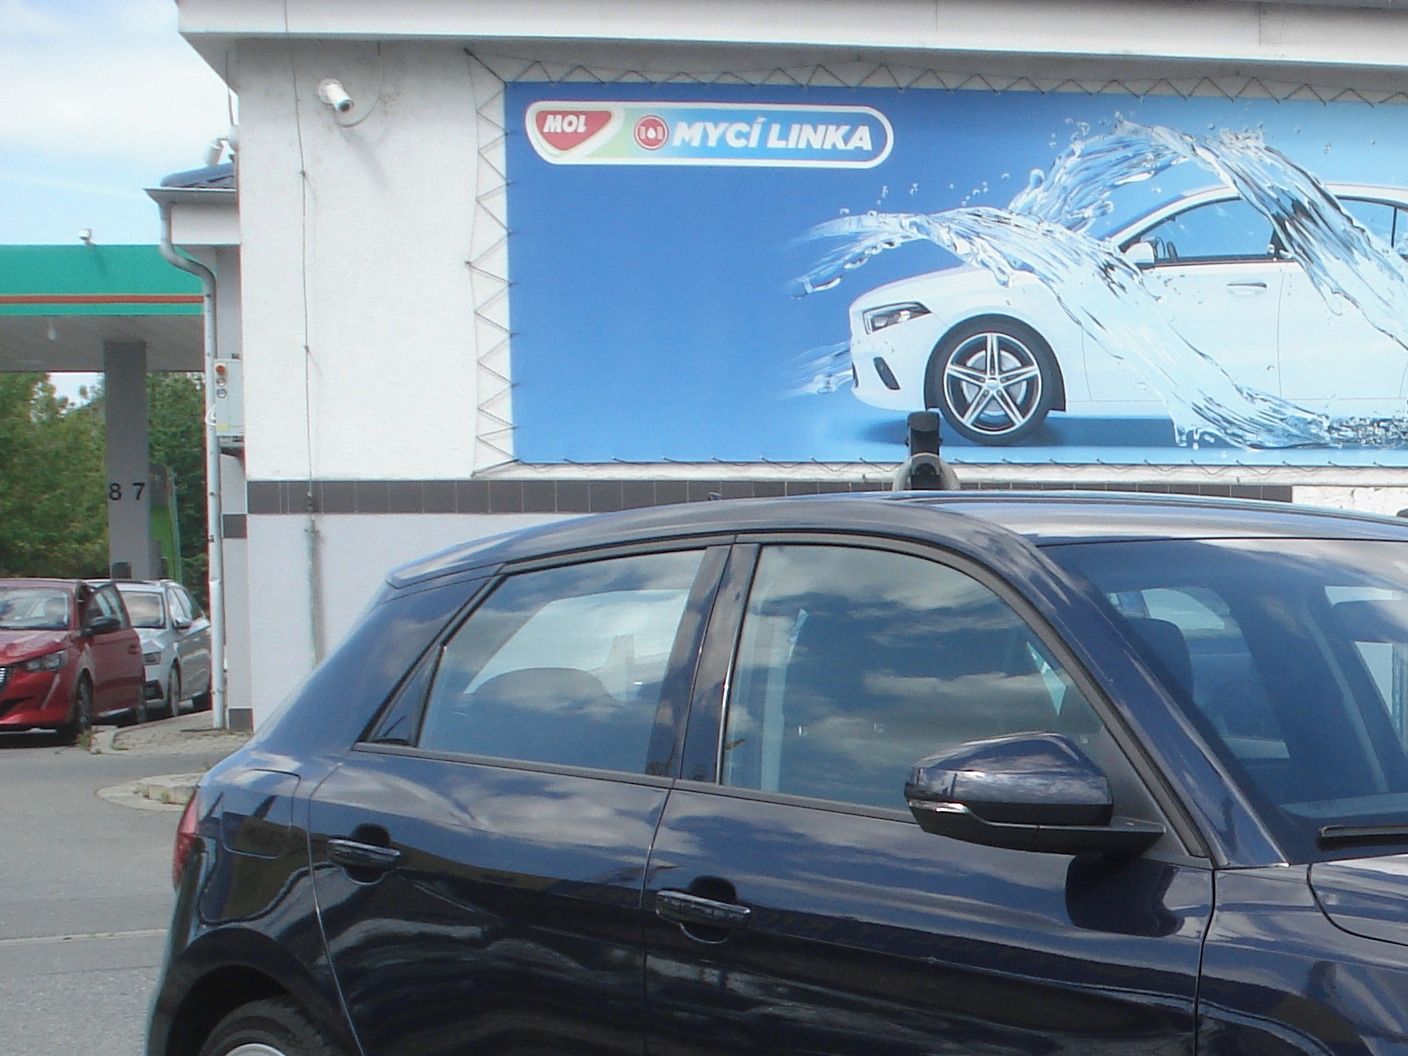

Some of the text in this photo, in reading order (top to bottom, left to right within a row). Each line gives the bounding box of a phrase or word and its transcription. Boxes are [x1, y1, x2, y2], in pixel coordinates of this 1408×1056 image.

[543, 114, 587, 133] MOL
[672, 115, 874, 151] MYCÍ LINKA
[109, 482, 145, 501] 8 7
